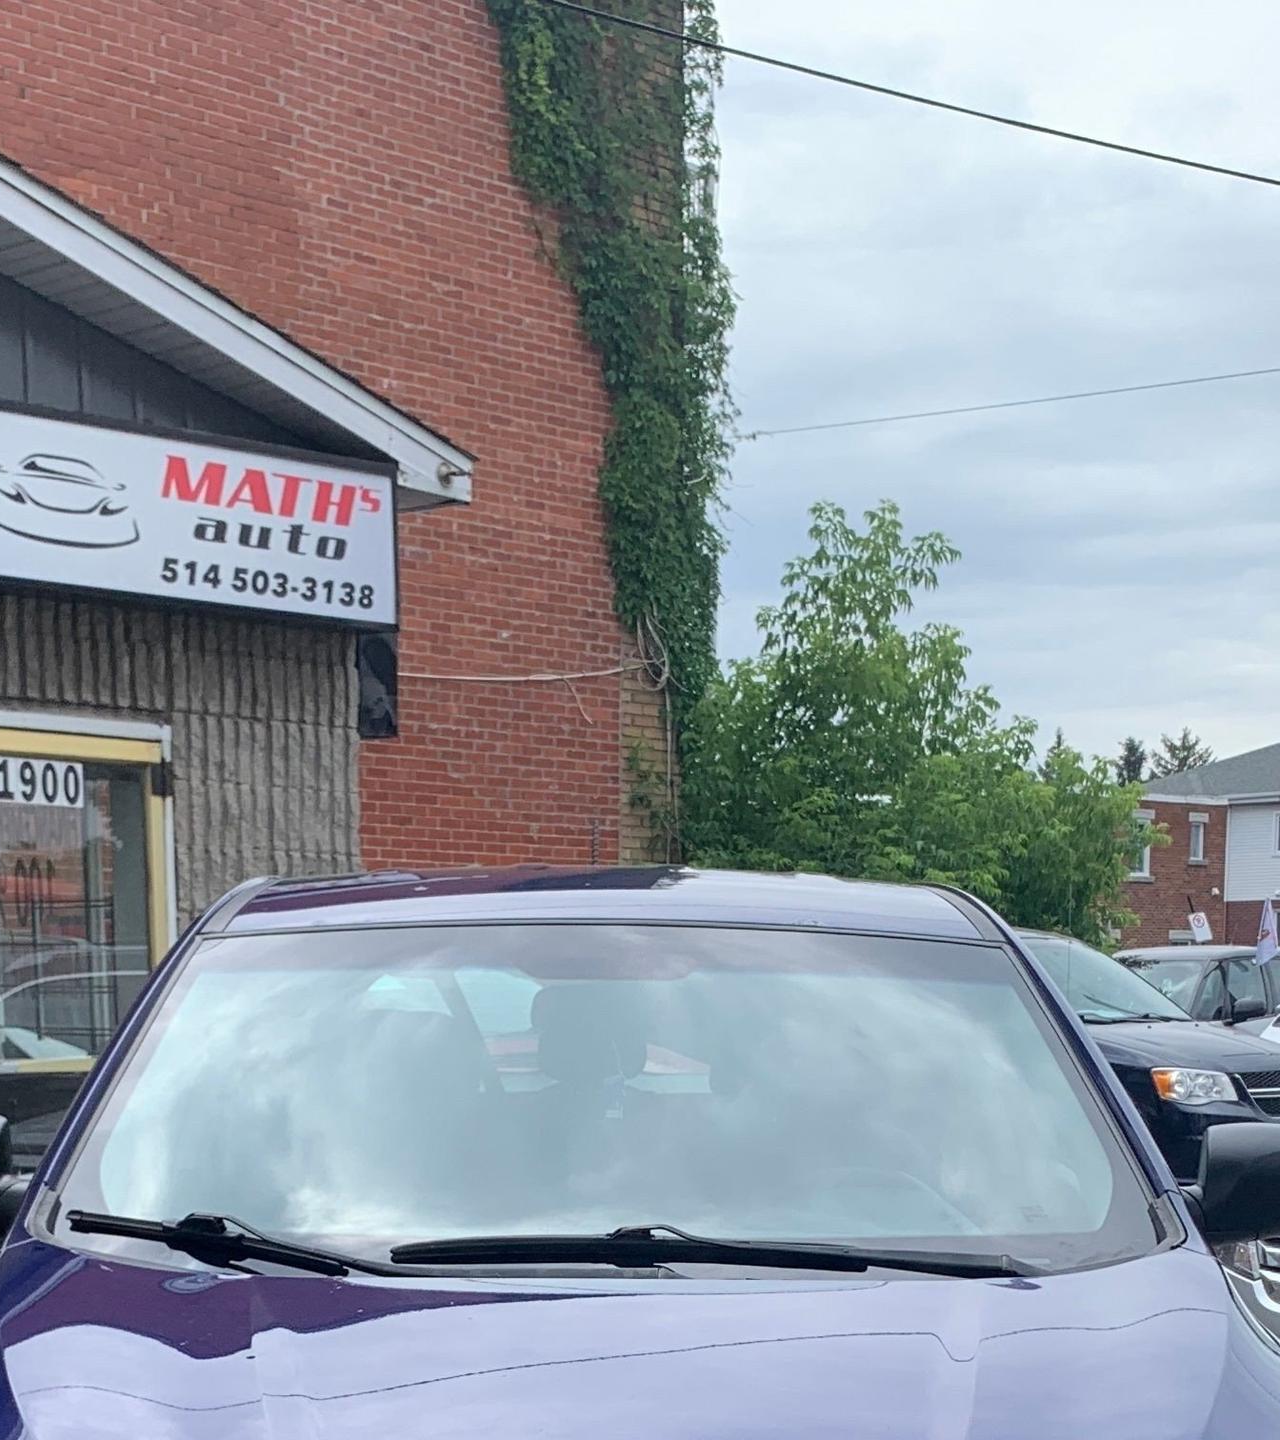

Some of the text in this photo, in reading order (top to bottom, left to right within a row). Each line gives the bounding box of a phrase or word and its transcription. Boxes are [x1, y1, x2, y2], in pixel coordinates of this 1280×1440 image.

[193, 516, 347, 560] auto
[161, 557, 375, 609] 514 503-3138
